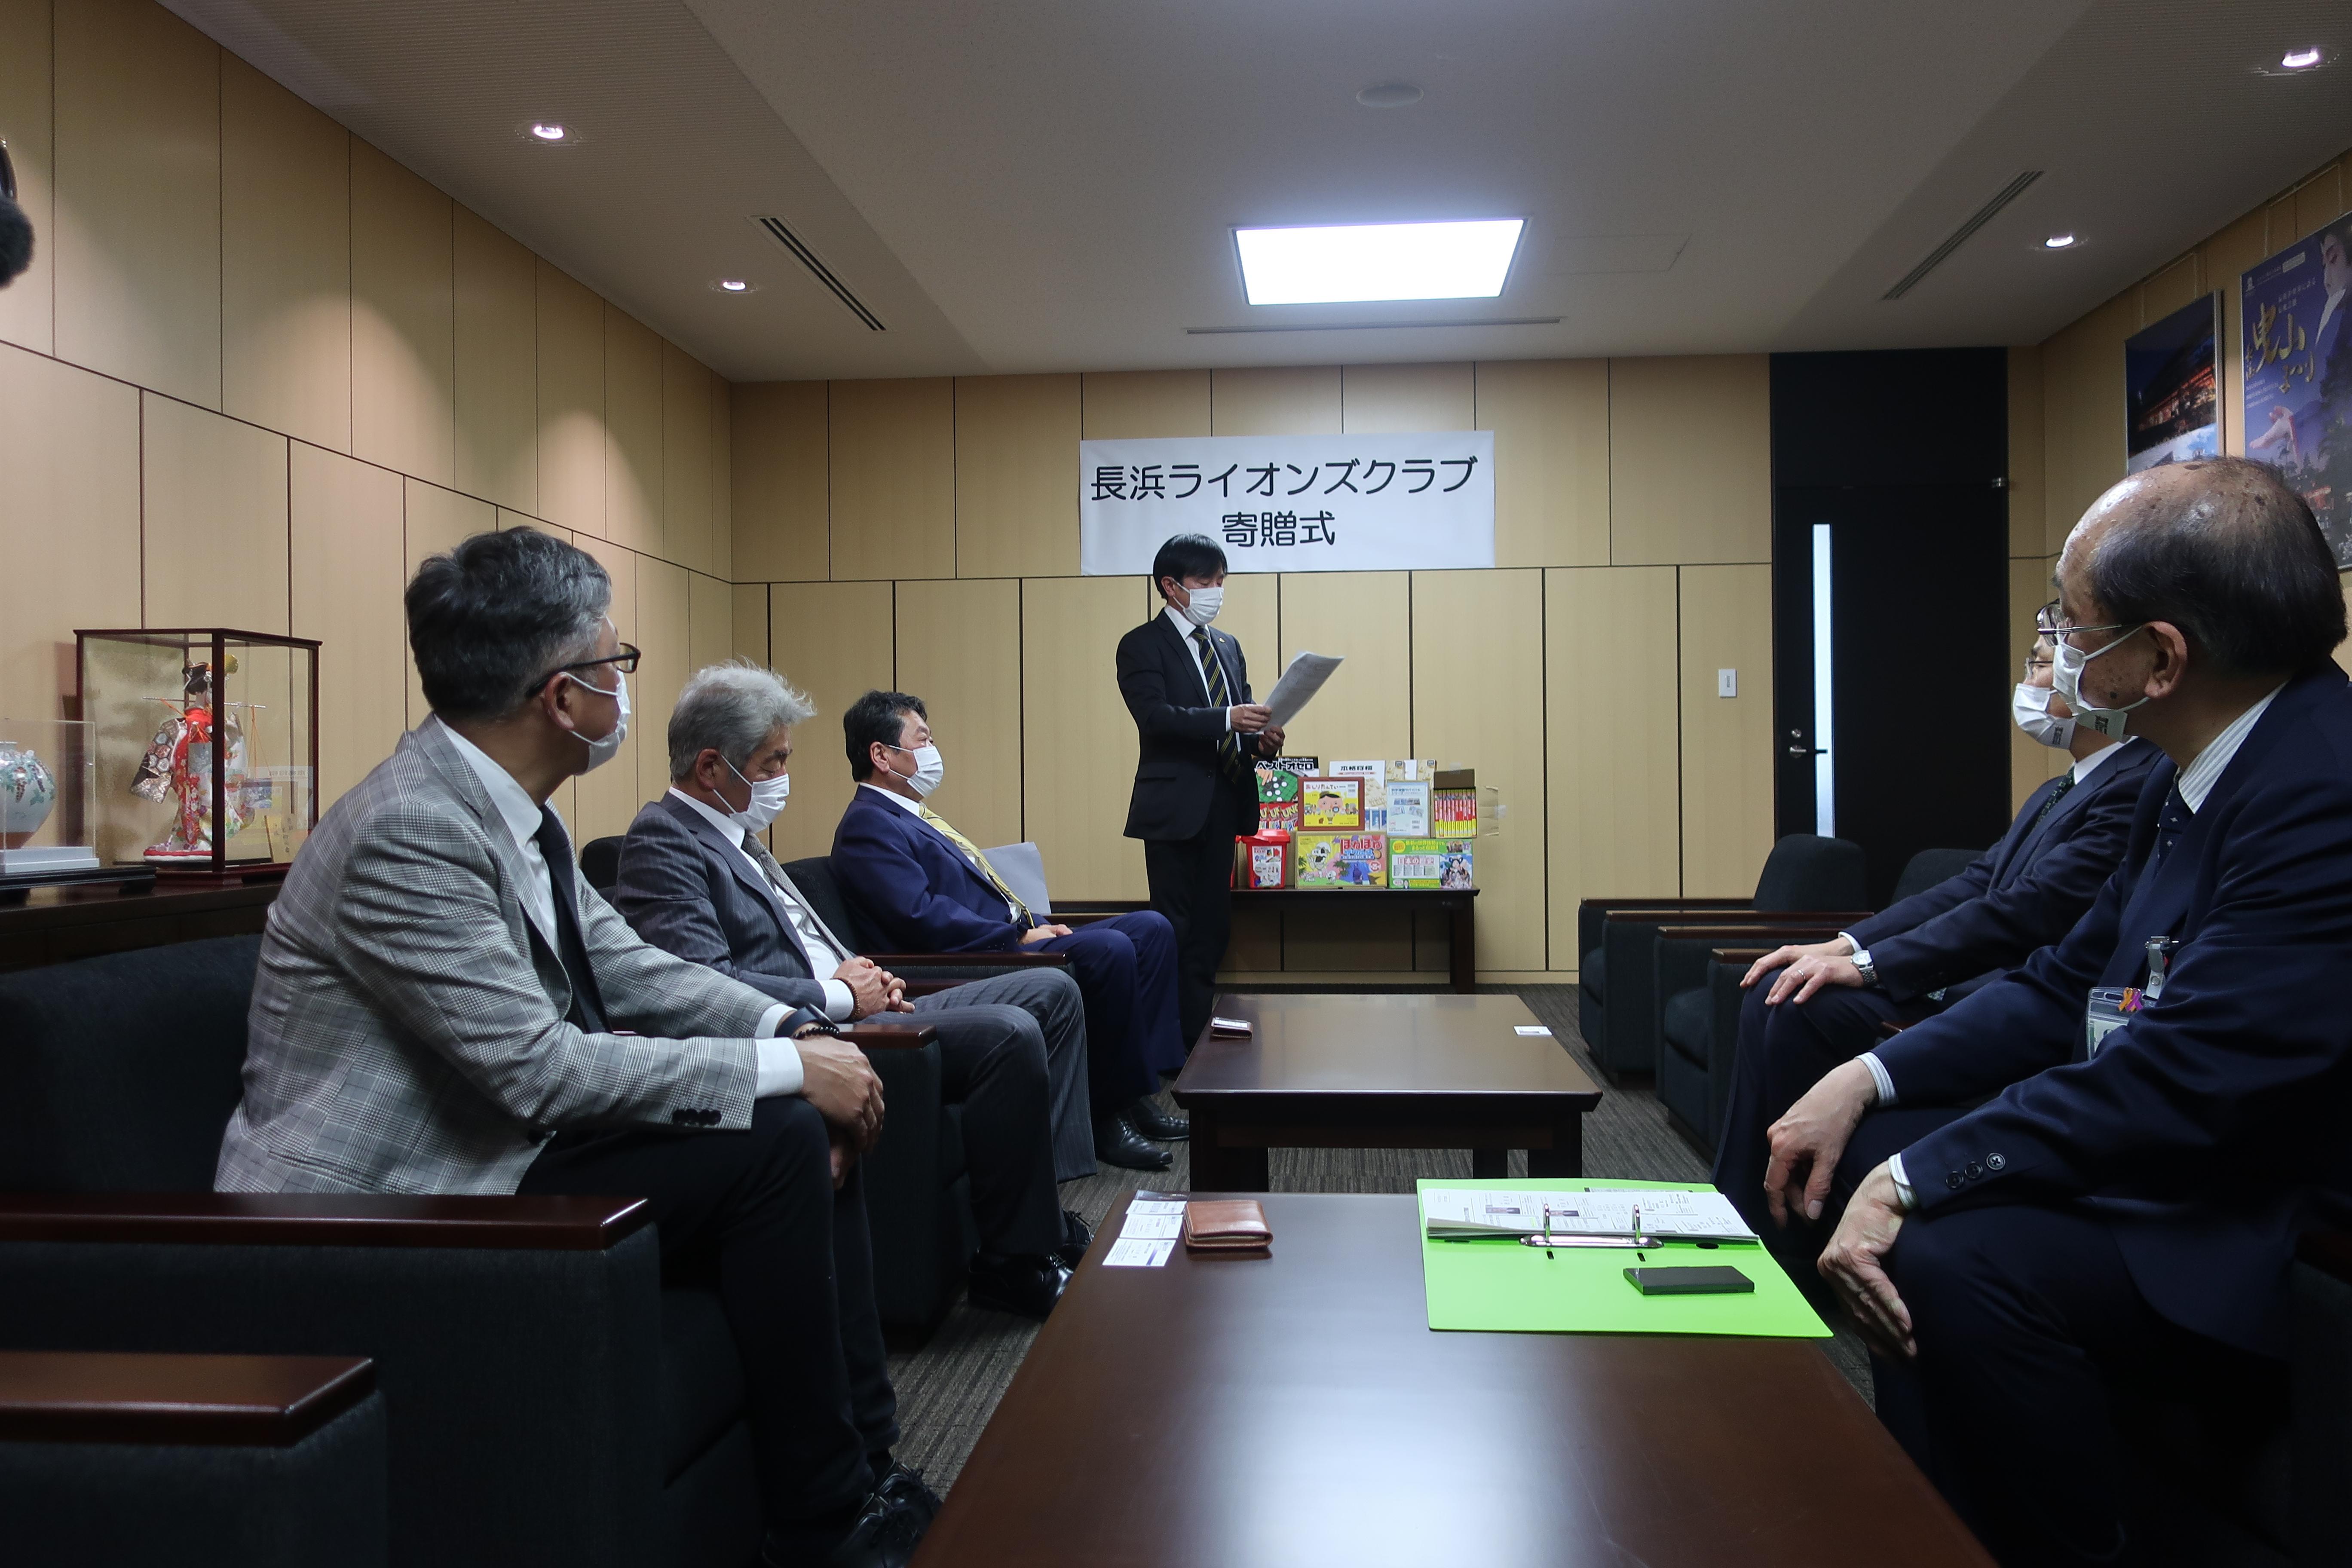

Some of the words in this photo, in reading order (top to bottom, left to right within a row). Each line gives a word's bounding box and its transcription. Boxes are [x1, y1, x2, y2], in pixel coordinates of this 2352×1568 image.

[1091, 456, 1477, 500] 長浜ライオンズクラブ
[1221, 510, 1335, 547] 寄贈式
